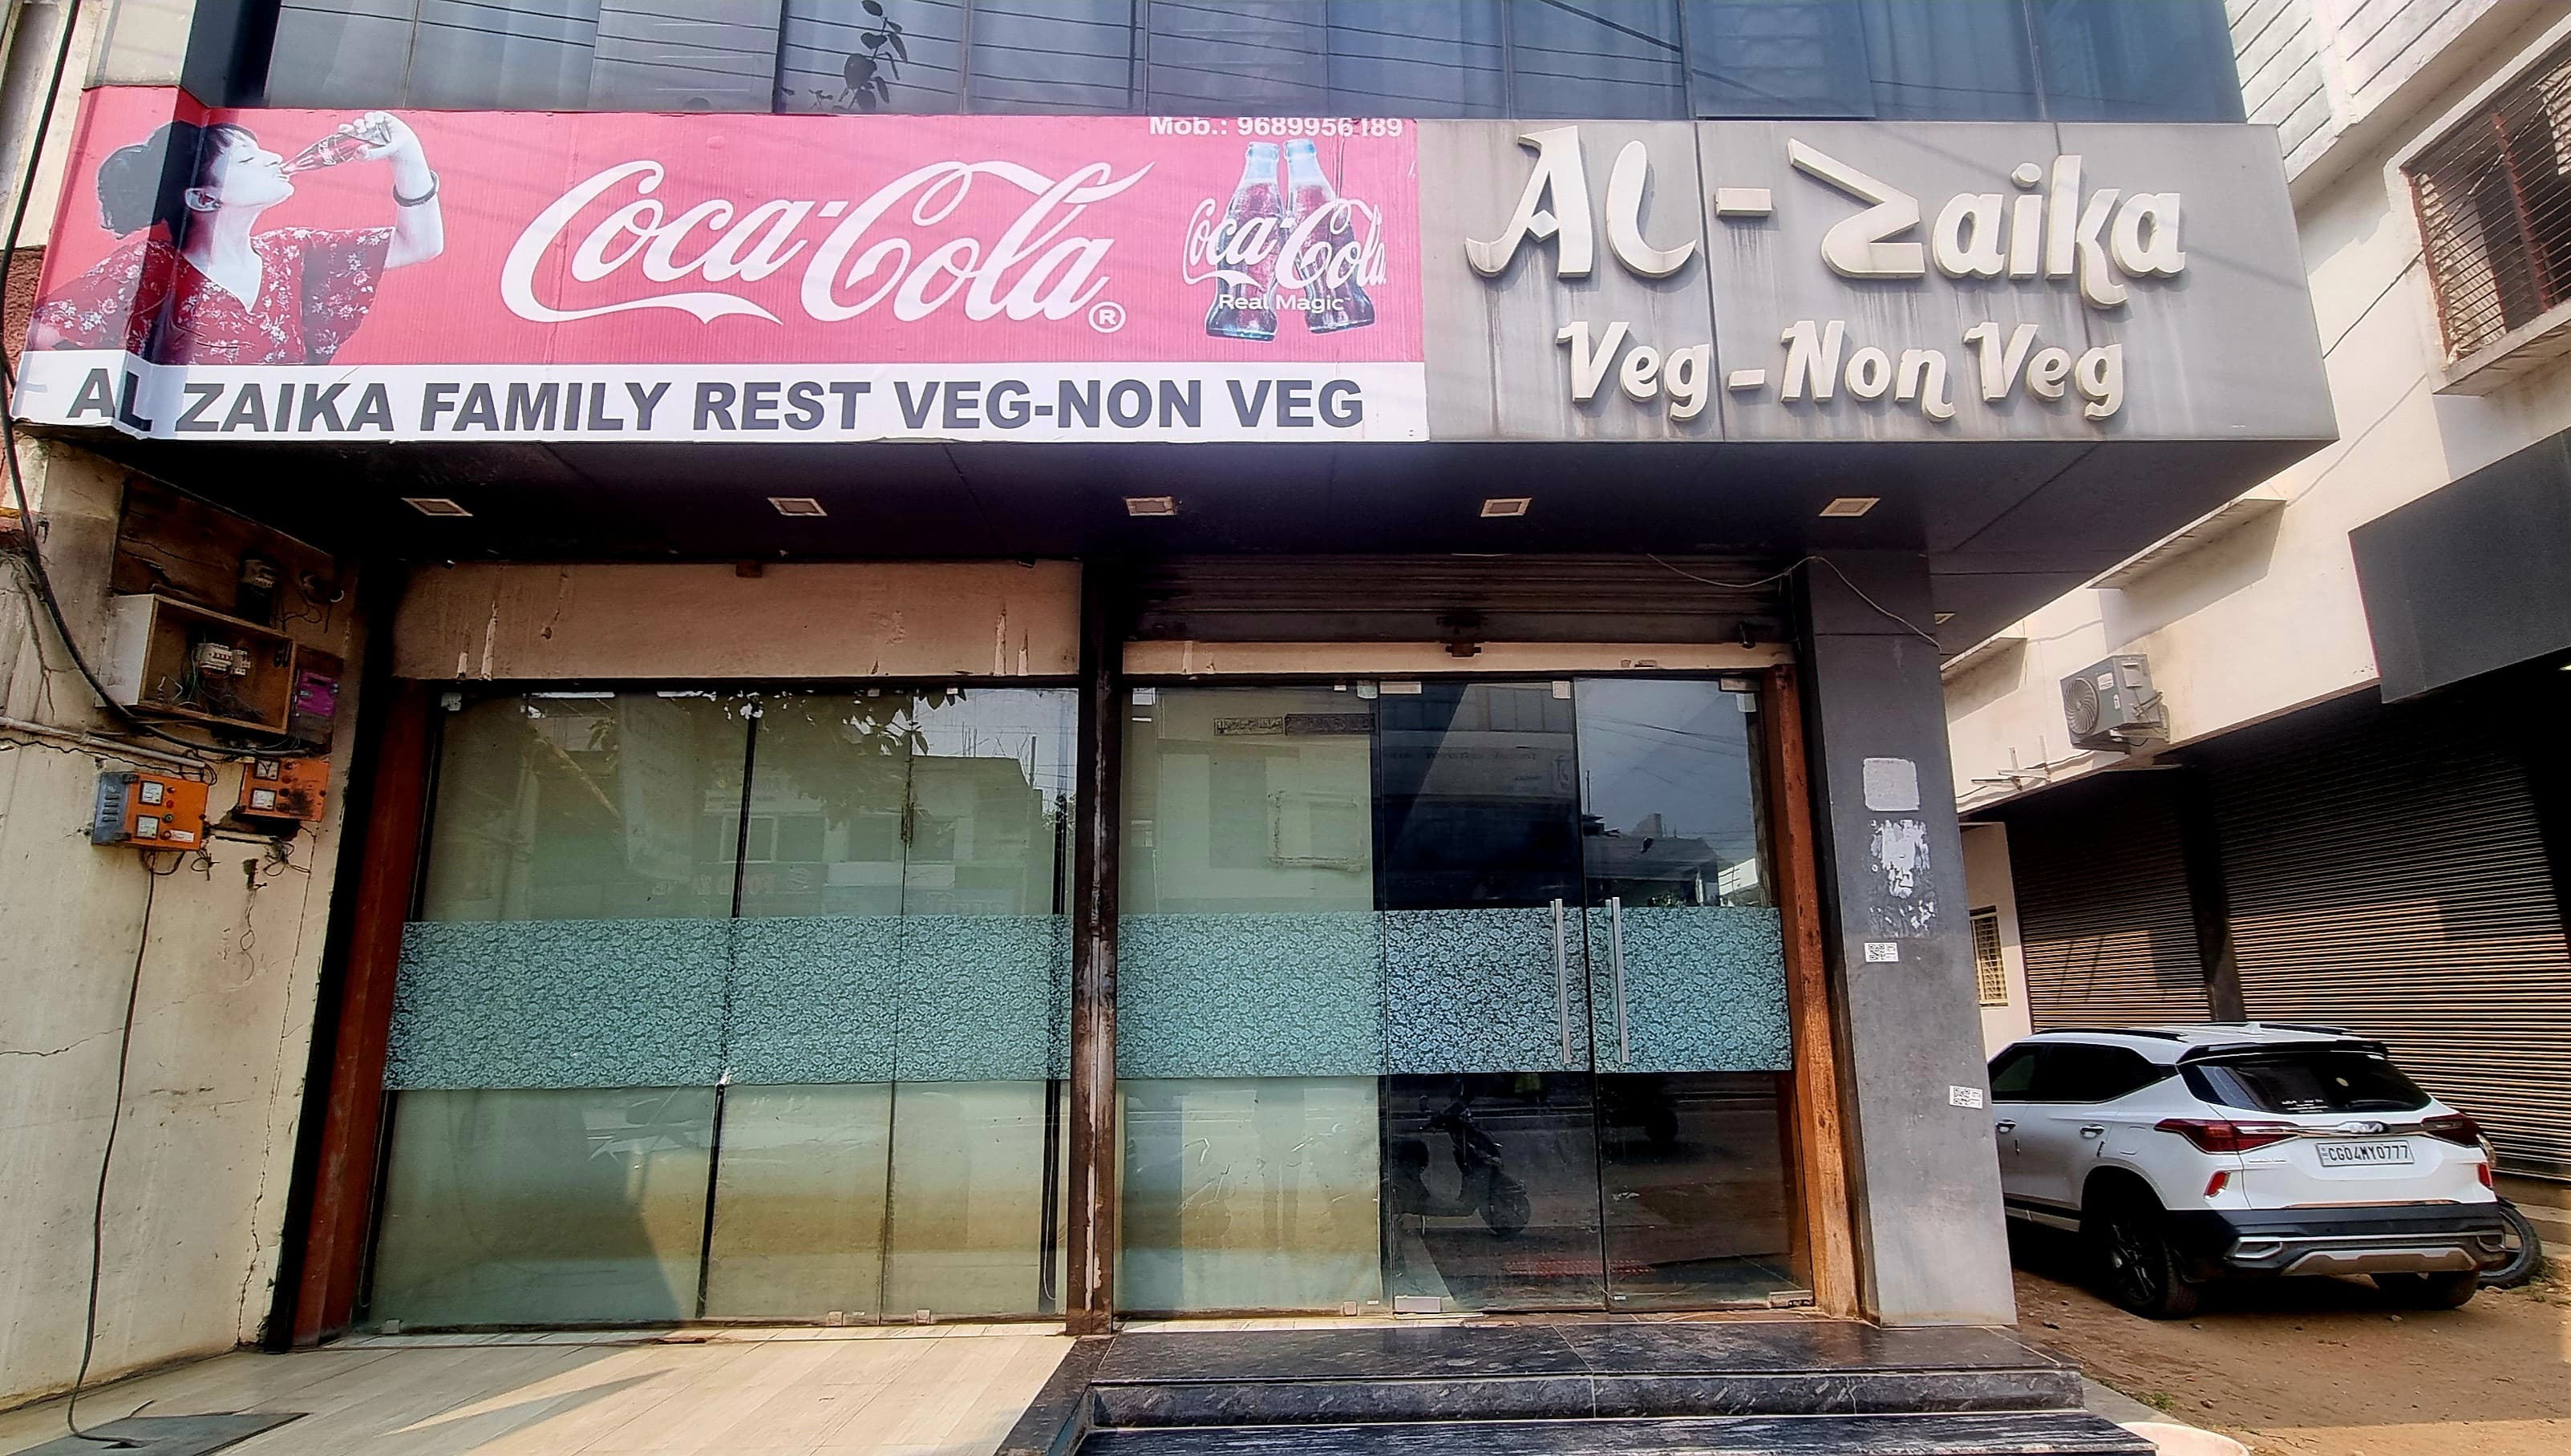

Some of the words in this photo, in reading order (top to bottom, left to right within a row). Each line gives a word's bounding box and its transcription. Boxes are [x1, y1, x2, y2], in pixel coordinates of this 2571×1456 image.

[1150, 116, 1227, 135] Mob.:
[501, 160, 1155, 325] Coca-Cola
[1183, 198, 1387, 289] Coca-Cola
[1219, 294, 1269, 310] Real
[67, 368, 153, 431] AL
[174, 382, 395, 432] ZAIKA
[418, 382, 670, 432] FAMILY
[693, 382, 871, 431] REST
[893, 379, 1205, 430] VEG-NON
[1225, 379, 1363, 427] VEG
[1963, 322, 2124, 420] Veg
